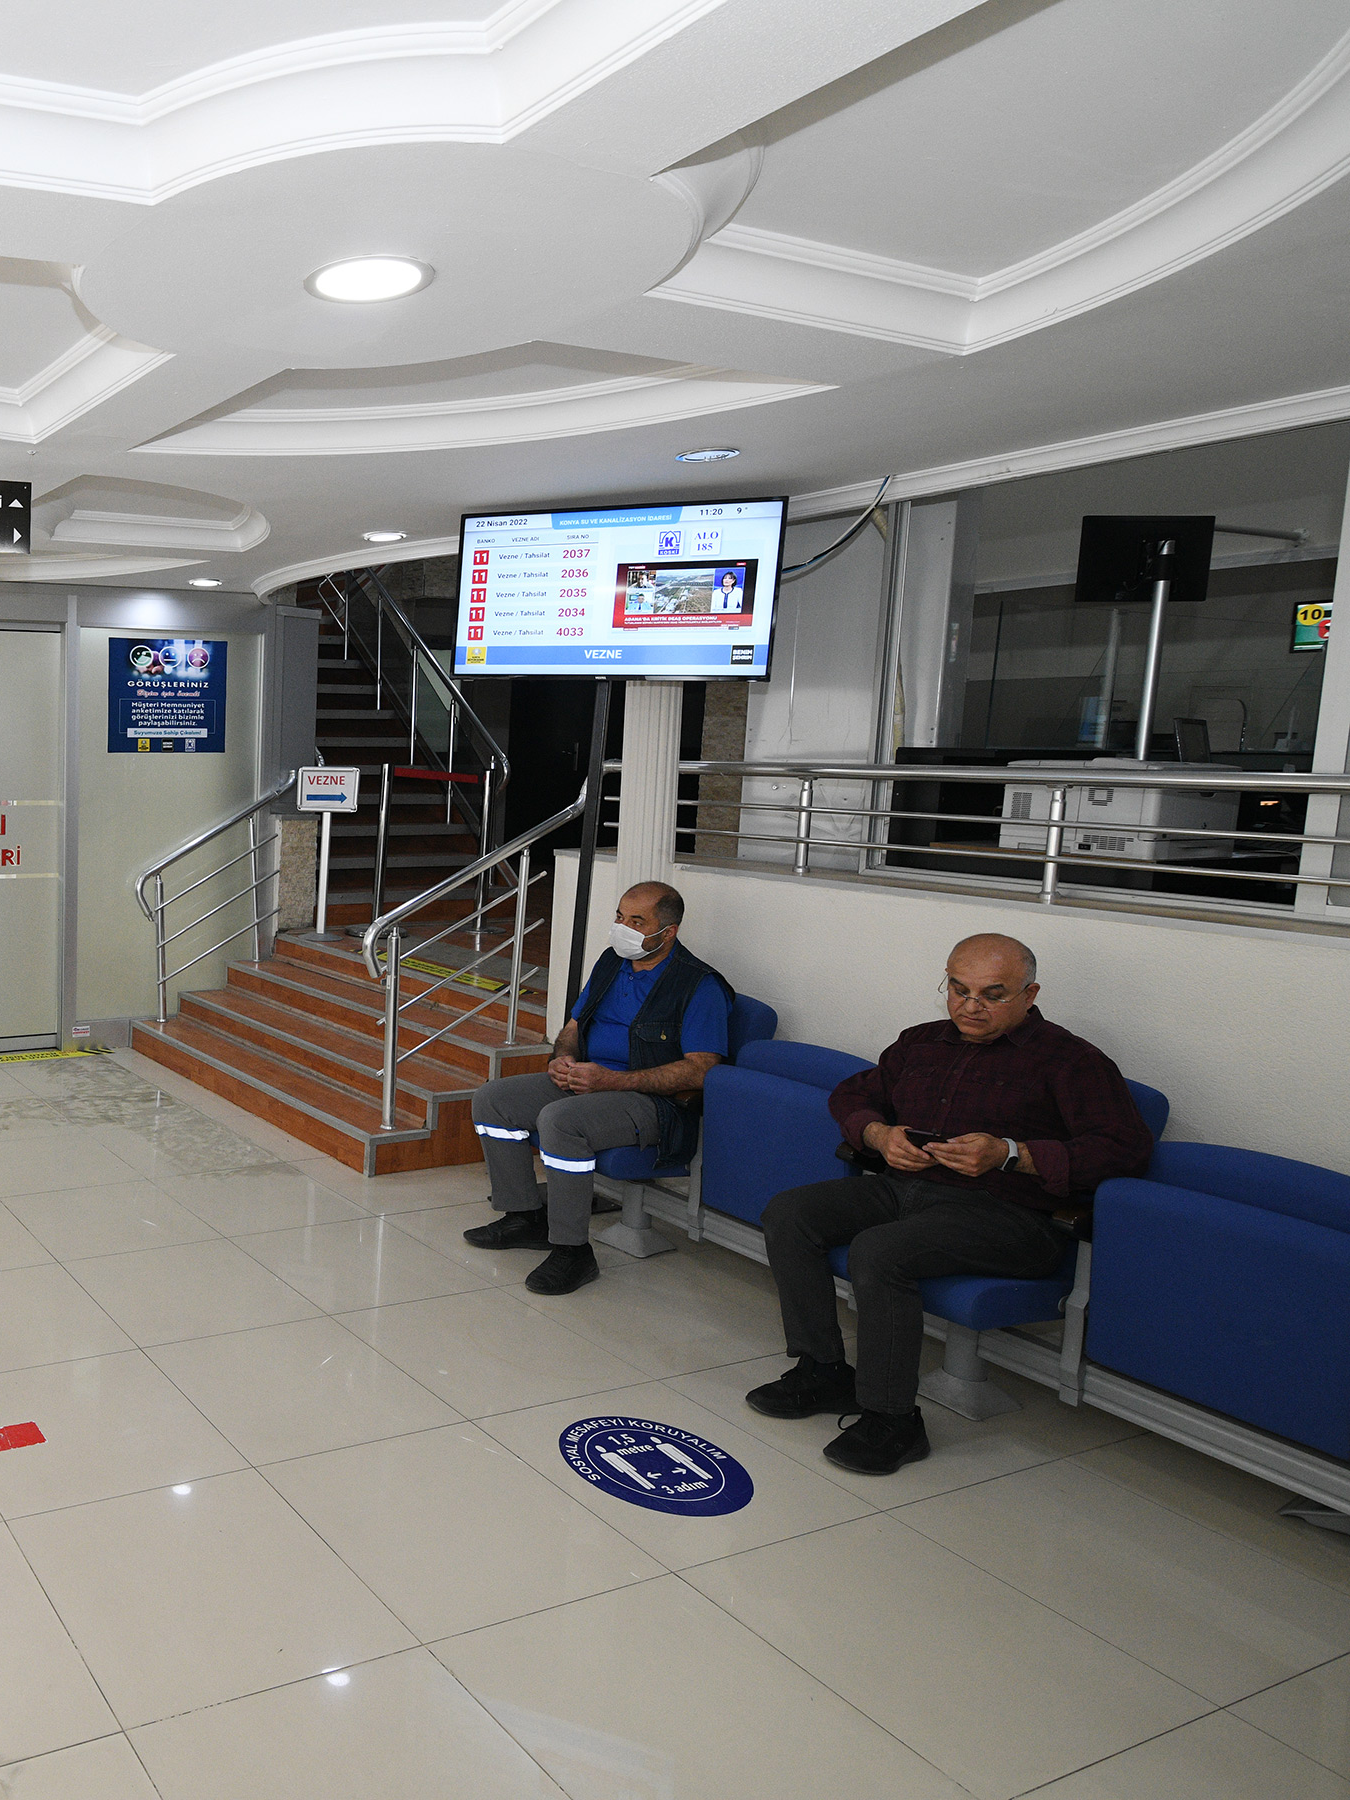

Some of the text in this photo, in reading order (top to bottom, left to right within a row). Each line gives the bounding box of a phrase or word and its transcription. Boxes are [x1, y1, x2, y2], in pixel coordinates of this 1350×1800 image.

[700, 508, 723, 516] 11:20
[476, 520, 486, 528] 22
[510, 518, 528, 526] 2022
[599, 516, 647, 524] KANALİZASYON
[648, 514, 672, 522] İDARESİ
[694, 531, 719, 540] ALO
[698, 542, 713, 551] 185
[474, 552, 488, 563] 11
[562, 548, 590, 559] 2037
[473, 572, 486, 582] 11
[561, 568, 589, 578] 2036
[472, 590, 485, 601] 11
[560, 588, 587, 598] 2035
[470, 609, 484, 620] 11
[558, 608, 586, 618] 2034
[1300, 608, 1322, 620] 10
[469, 628, 482, 638] 11
[556, 627, 584, 636] 4033
[584, 649, 622, 660] VEZNE
[127, 679, 209, 688] GÖRÜŞLERİNİZ
[307, 775, 346, 786] VEZNE
[608, 1433, 636, 1446] 1,5
[566, 1418, 728, 1482] SOSYAL MESAFEYİ KORUYALIM
[616, 1444, 654, 1456] metre
[661, 1480, 709, 1494] 3 adım
